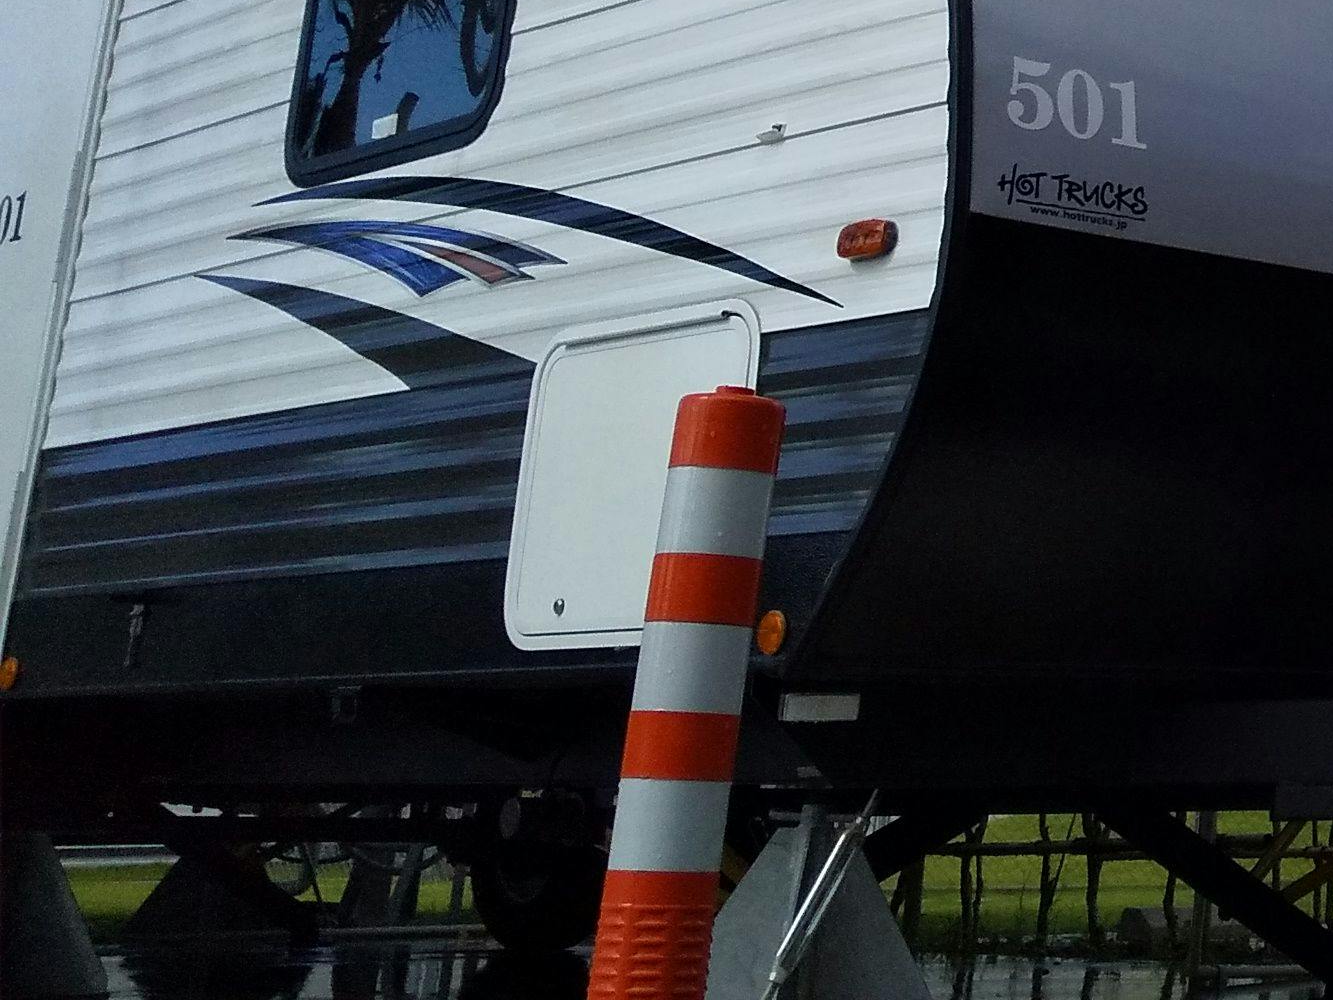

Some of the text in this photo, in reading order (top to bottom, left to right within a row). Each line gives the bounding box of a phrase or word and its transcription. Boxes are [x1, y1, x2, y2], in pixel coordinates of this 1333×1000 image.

[1007, 56, 1148, 149] 501
[997, 163, 1149, 215] HOT TRUCKS
[1029, 205, 1128, 231] www.hottrucks.jp
